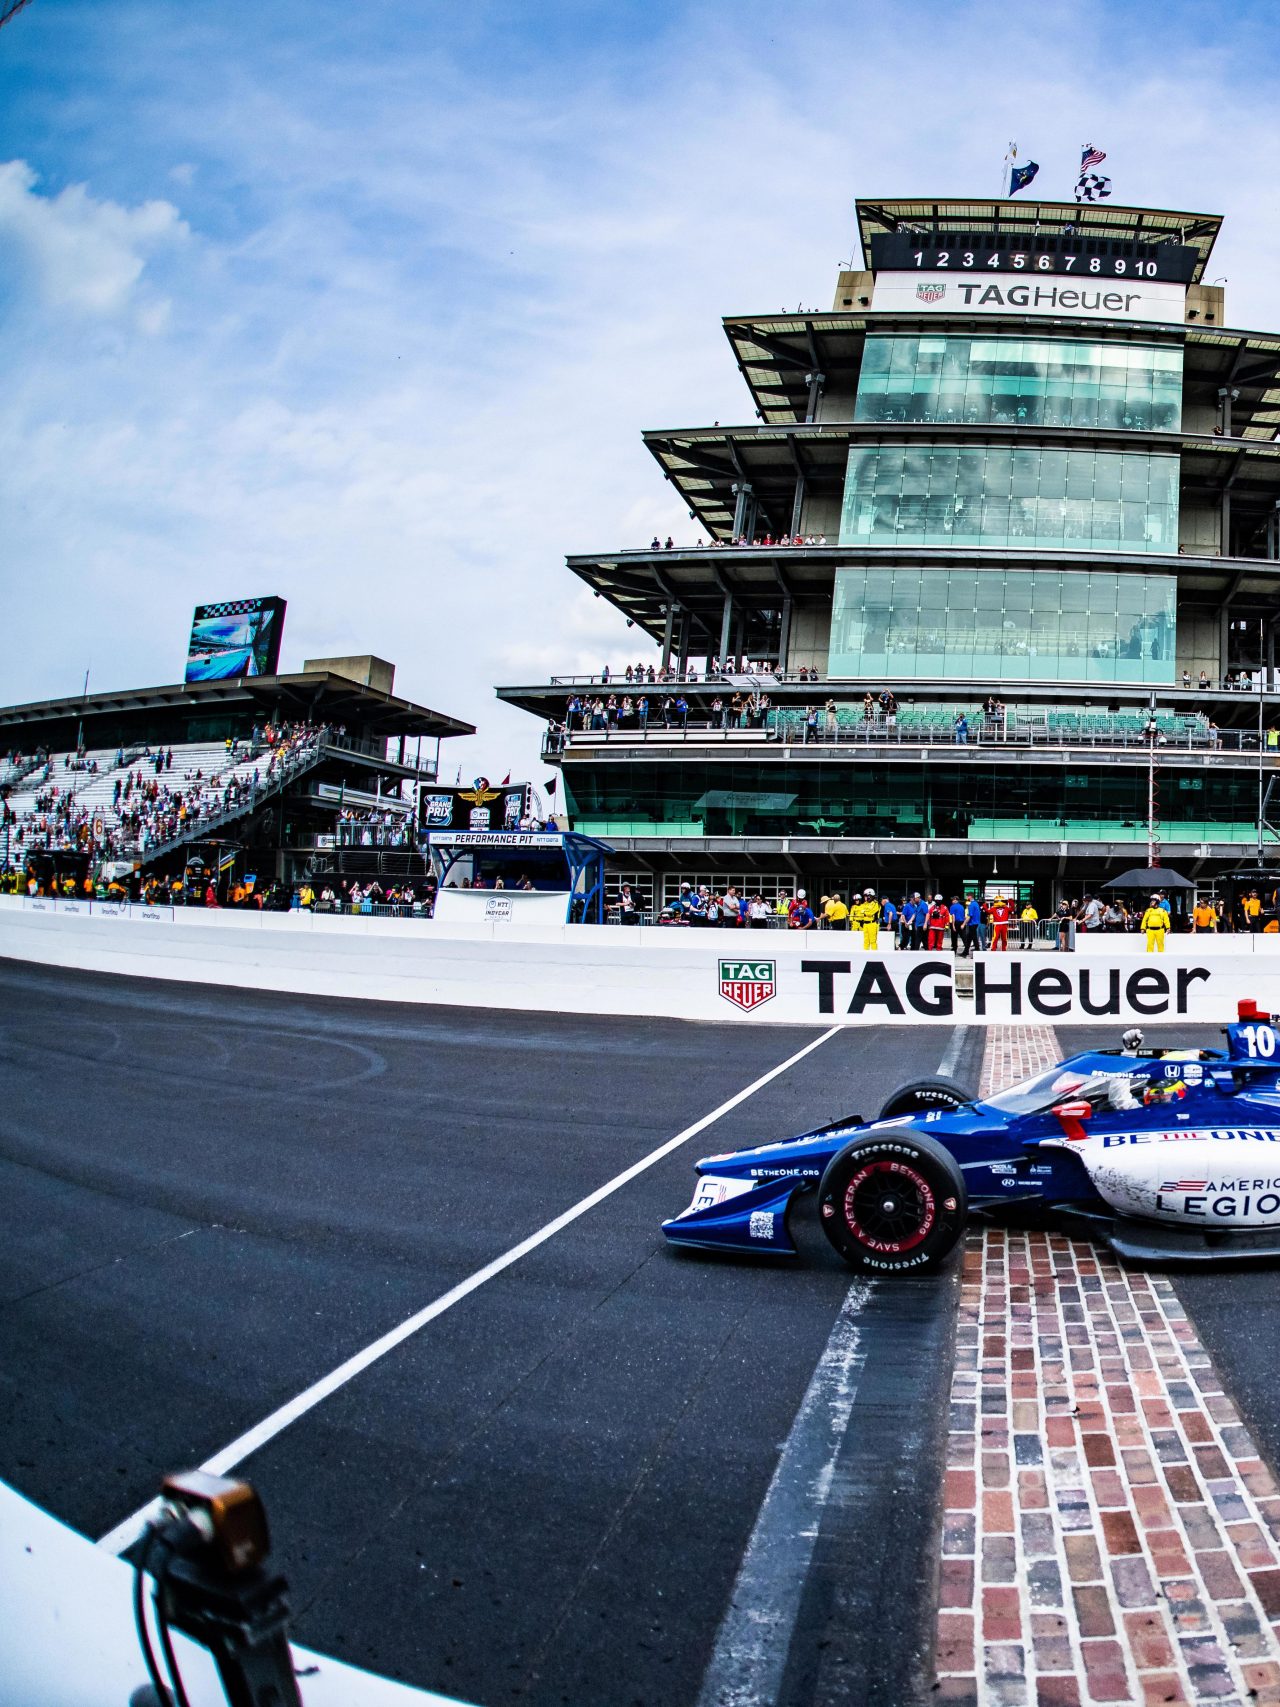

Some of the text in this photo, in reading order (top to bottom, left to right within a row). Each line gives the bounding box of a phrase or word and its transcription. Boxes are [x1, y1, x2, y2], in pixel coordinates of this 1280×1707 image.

[914, 252, 1157, 276] 1 2 3 4 5 6 7 8 9 10
[920, 284, 943, 292] TAG
[918, 292, 945, 303] HEUER
[428, 807, 451, 817] PRIX
[506, 807, 520, 817] PRIX
[96, 819, 102, 834] 6
[455, 835, 534, 844] PERFORMANCE PIT
[726, 963, 770, 980] TAG
[723, 983, 772, 1008] HEUER
[1243, 1026, 1276, 1057] 10
[1103, 1133, 1149, 1148] BE
[851, 1143, 919, 1160] Firestone
[845, 1170, 867, 1228] VETERAN
[858, 1230, 866, 1238] A
[867, 1241, 900, 1252] SAVE
[863, 1252, 930, 1270] Firestone
